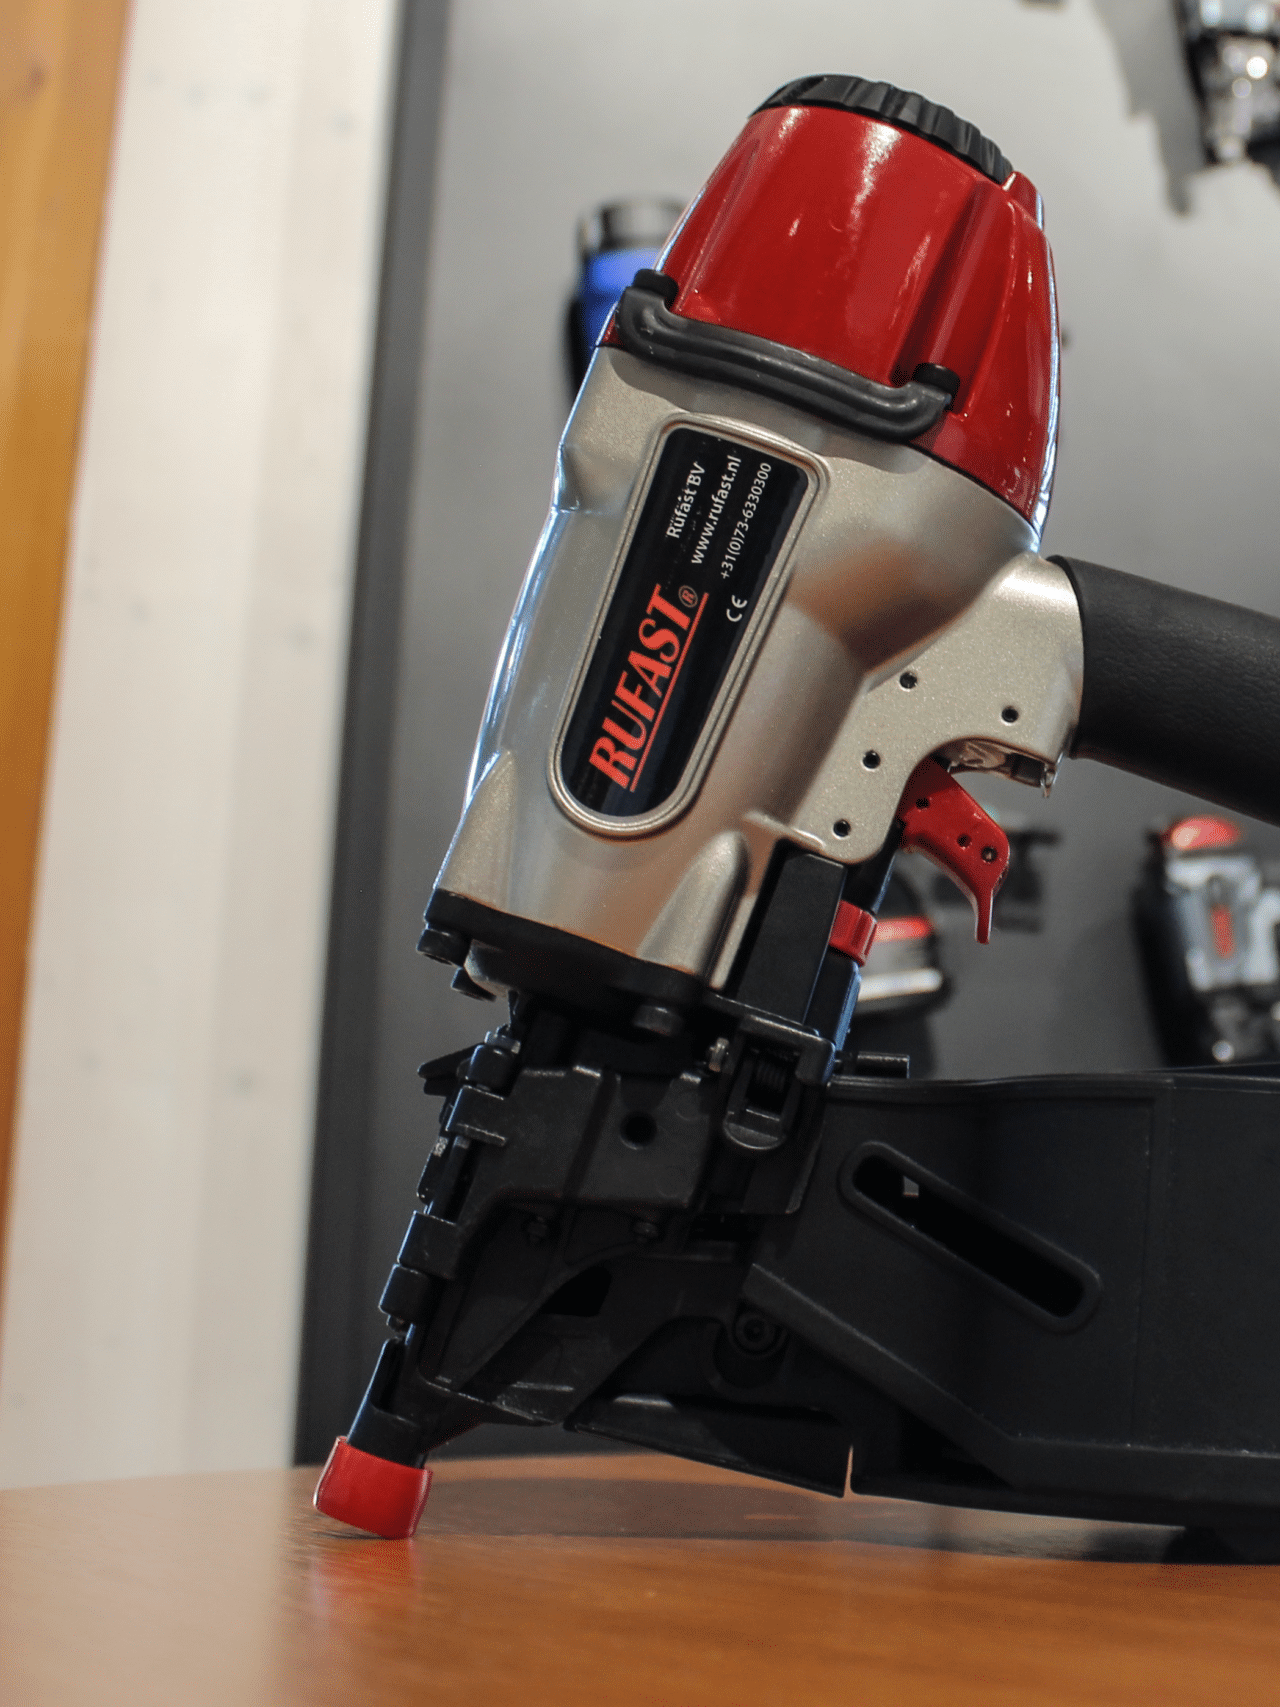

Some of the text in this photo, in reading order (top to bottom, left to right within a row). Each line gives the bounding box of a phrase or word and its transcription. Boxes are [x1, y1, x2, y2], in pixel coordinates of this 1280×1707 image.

[666, 462, 706, 539] Rufast BV
[691, 455, 742, 564] www.rufast.nl
[720, 462, 772, 580] +31(0)73-6330300
